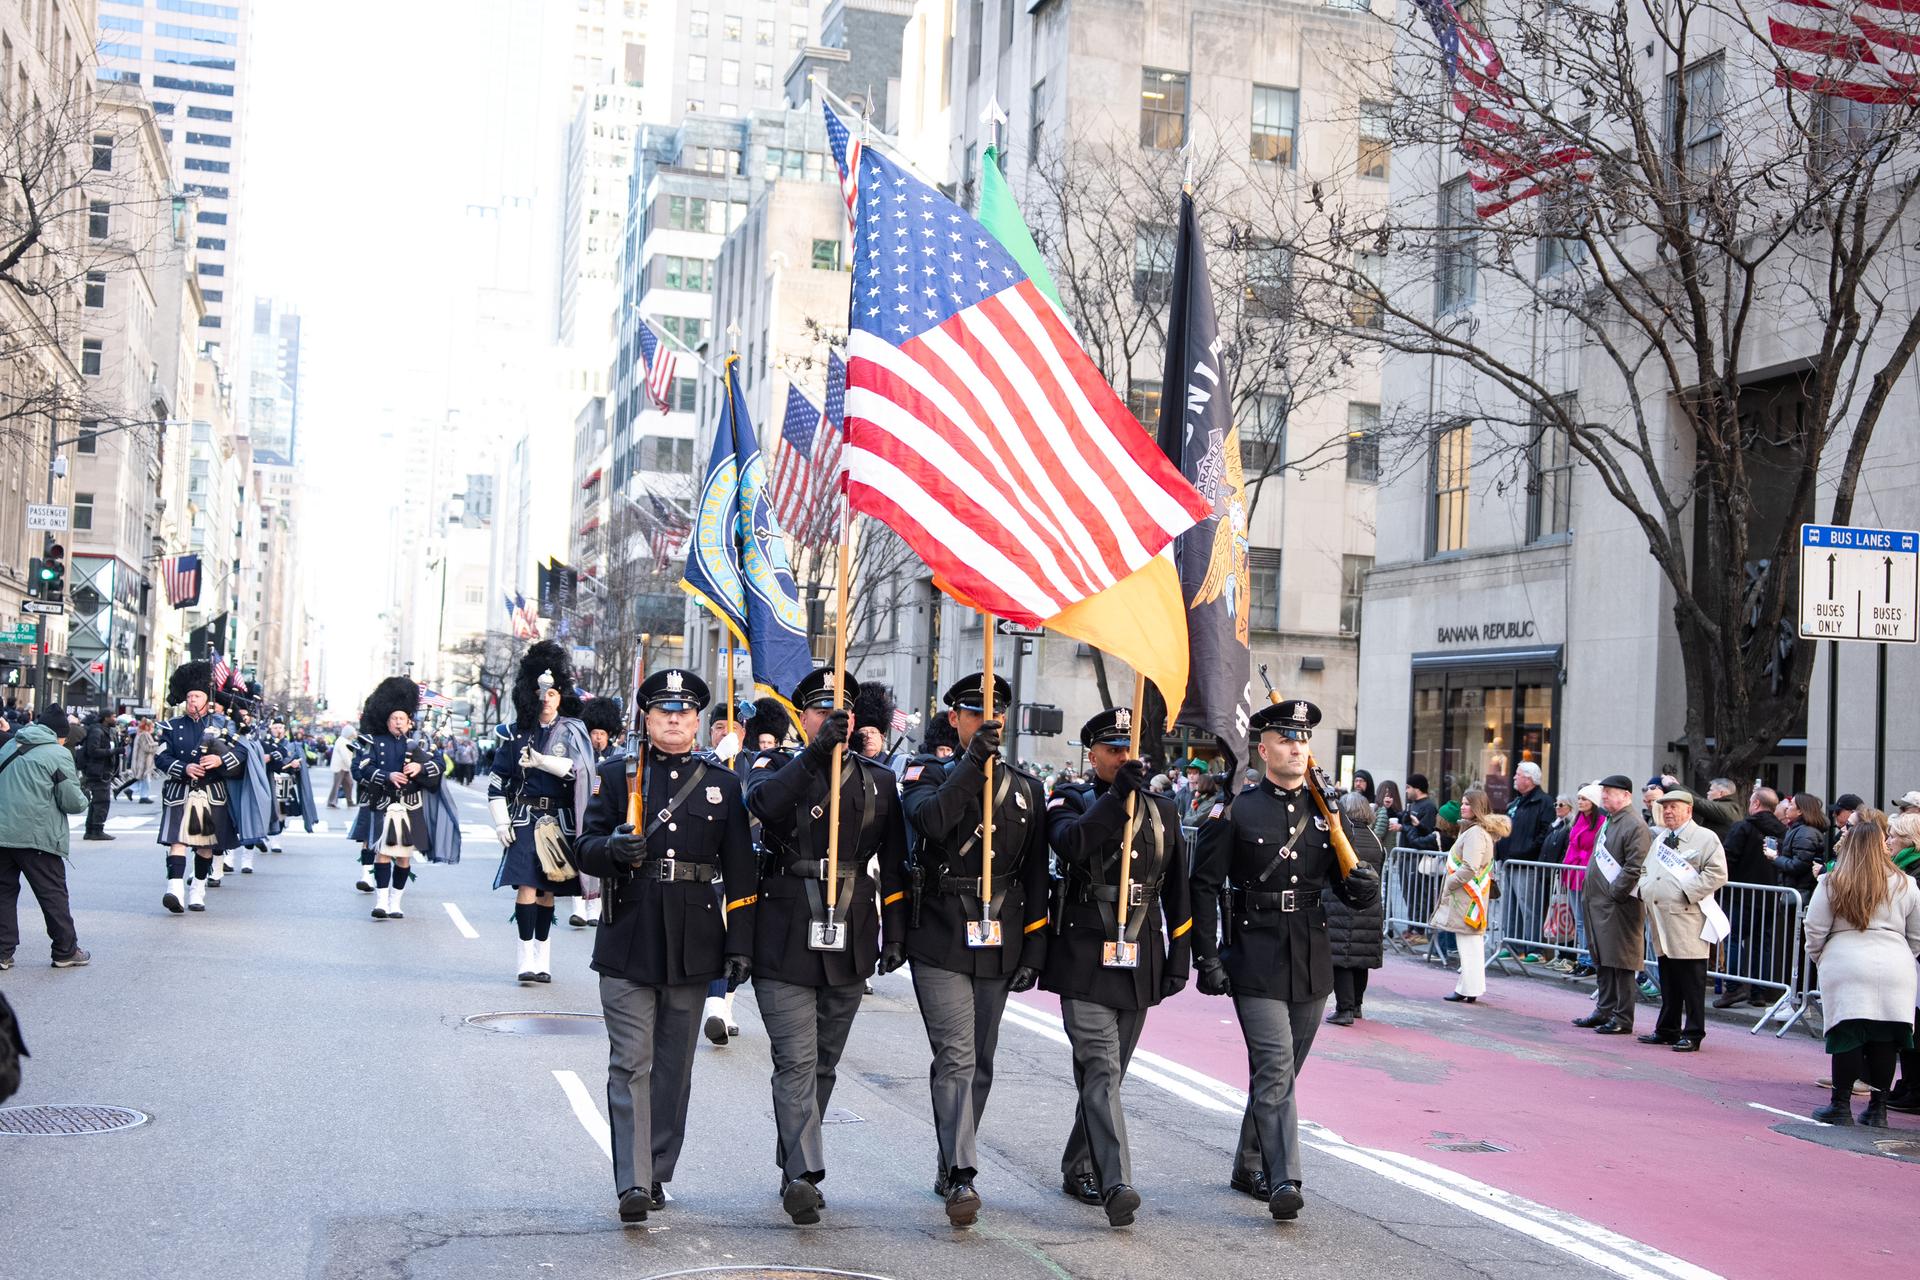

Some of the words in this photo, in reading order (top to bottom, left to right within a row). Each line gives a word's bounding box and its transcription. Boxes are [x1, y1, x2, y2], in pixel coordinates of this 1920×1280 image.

[1200, 439, 1223, 497] ARAMUS
[1207, 456, 1225, 501] POLIC
[29, 507, 67, 516] PASSENGER
[29, 517, 46, 525] CARS
[50, 519, 66, 527] ONLY
[700, 483, 727, 573] BERGEN
[1830, 531, 1852, 545] BUS
[1856, 533, 1891, 548] LANES
[1816, 604, 1845, 618] BUSES
[1873, 607, 1902, 621] BUSES
[1004, 620, 1018, 631] ONE
[1438, 624, 1479, 643] BANANA
[1483, 620, 1534, 640] REPUBLIC
[1818, 620, 1842, 633] ONLY
[1875, 623, 1899, 636] ONLY
